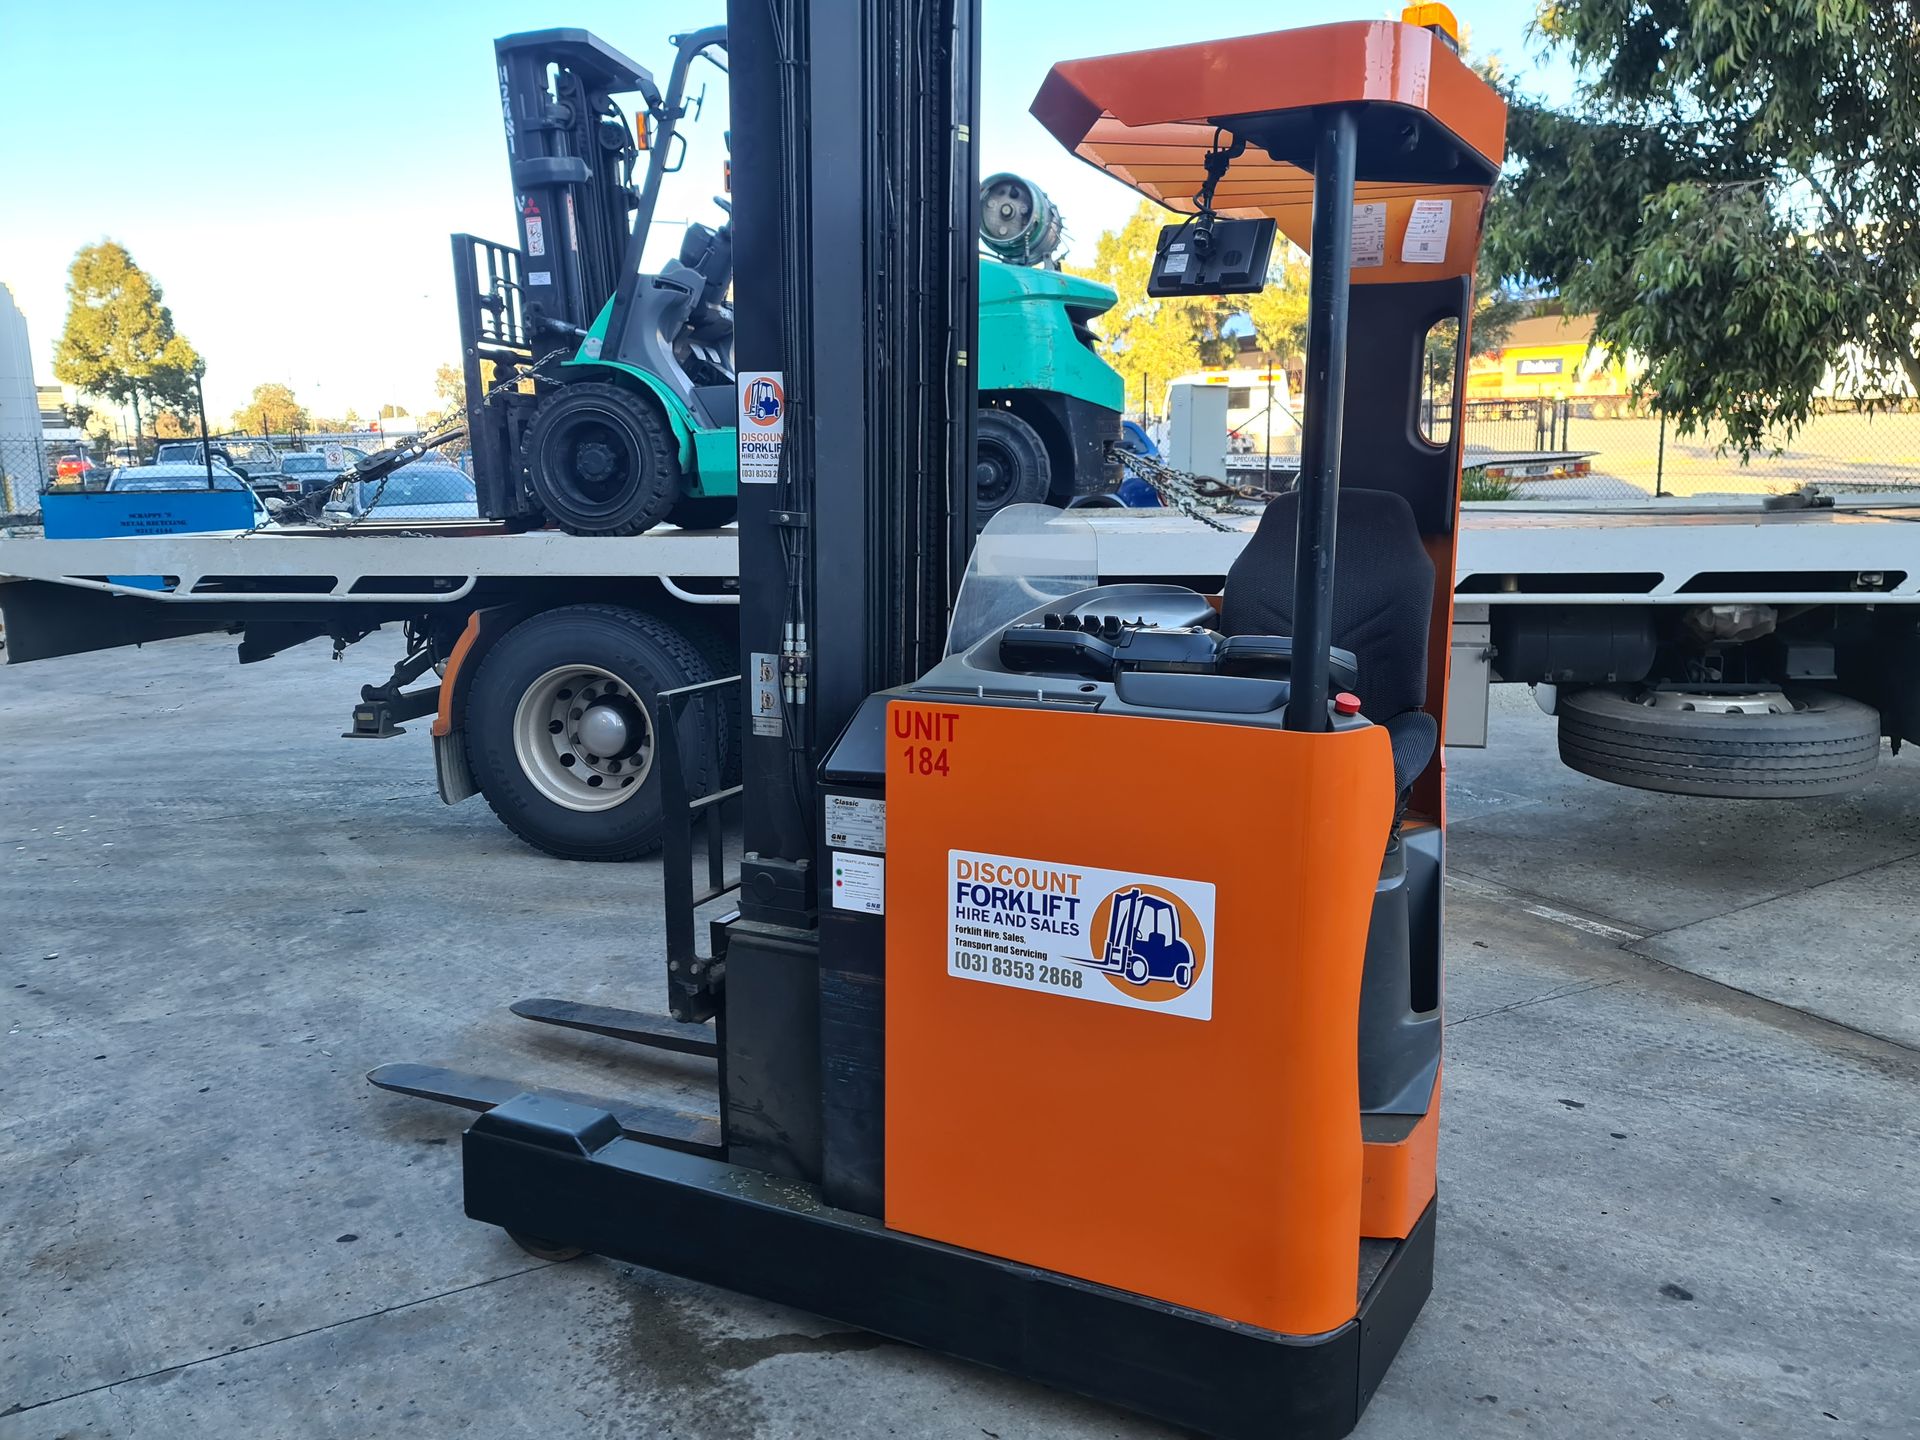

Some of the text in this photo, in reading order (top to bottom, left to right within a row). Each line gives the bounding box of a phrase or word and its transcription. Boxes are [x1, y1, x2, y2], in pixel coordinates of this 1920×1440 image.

[741, 433, 783, 442] DISCOUN
[741, 443, 782, 452] FORKLIF
[756, 470, 772, 478] 8353
[894, 709, 959, 742] UNIT
[904, 745, 950, 777] 184
[834, 798, 859, 807] Classic
[831, 833, 847, 841] GNB
[956, 859, 1082, 896] DISCOUNT
[956, 882, 1080, 921] FORKLIFT
[955, 905, 1080, 937] HIRE AND SALES
[955, 924, 983, 938] Forklift
[955, 937, 1048, 961] Transport and Servicing
[991, 958, 1035, 982] 8353
[1038, 965, 1083, 990] 2868
